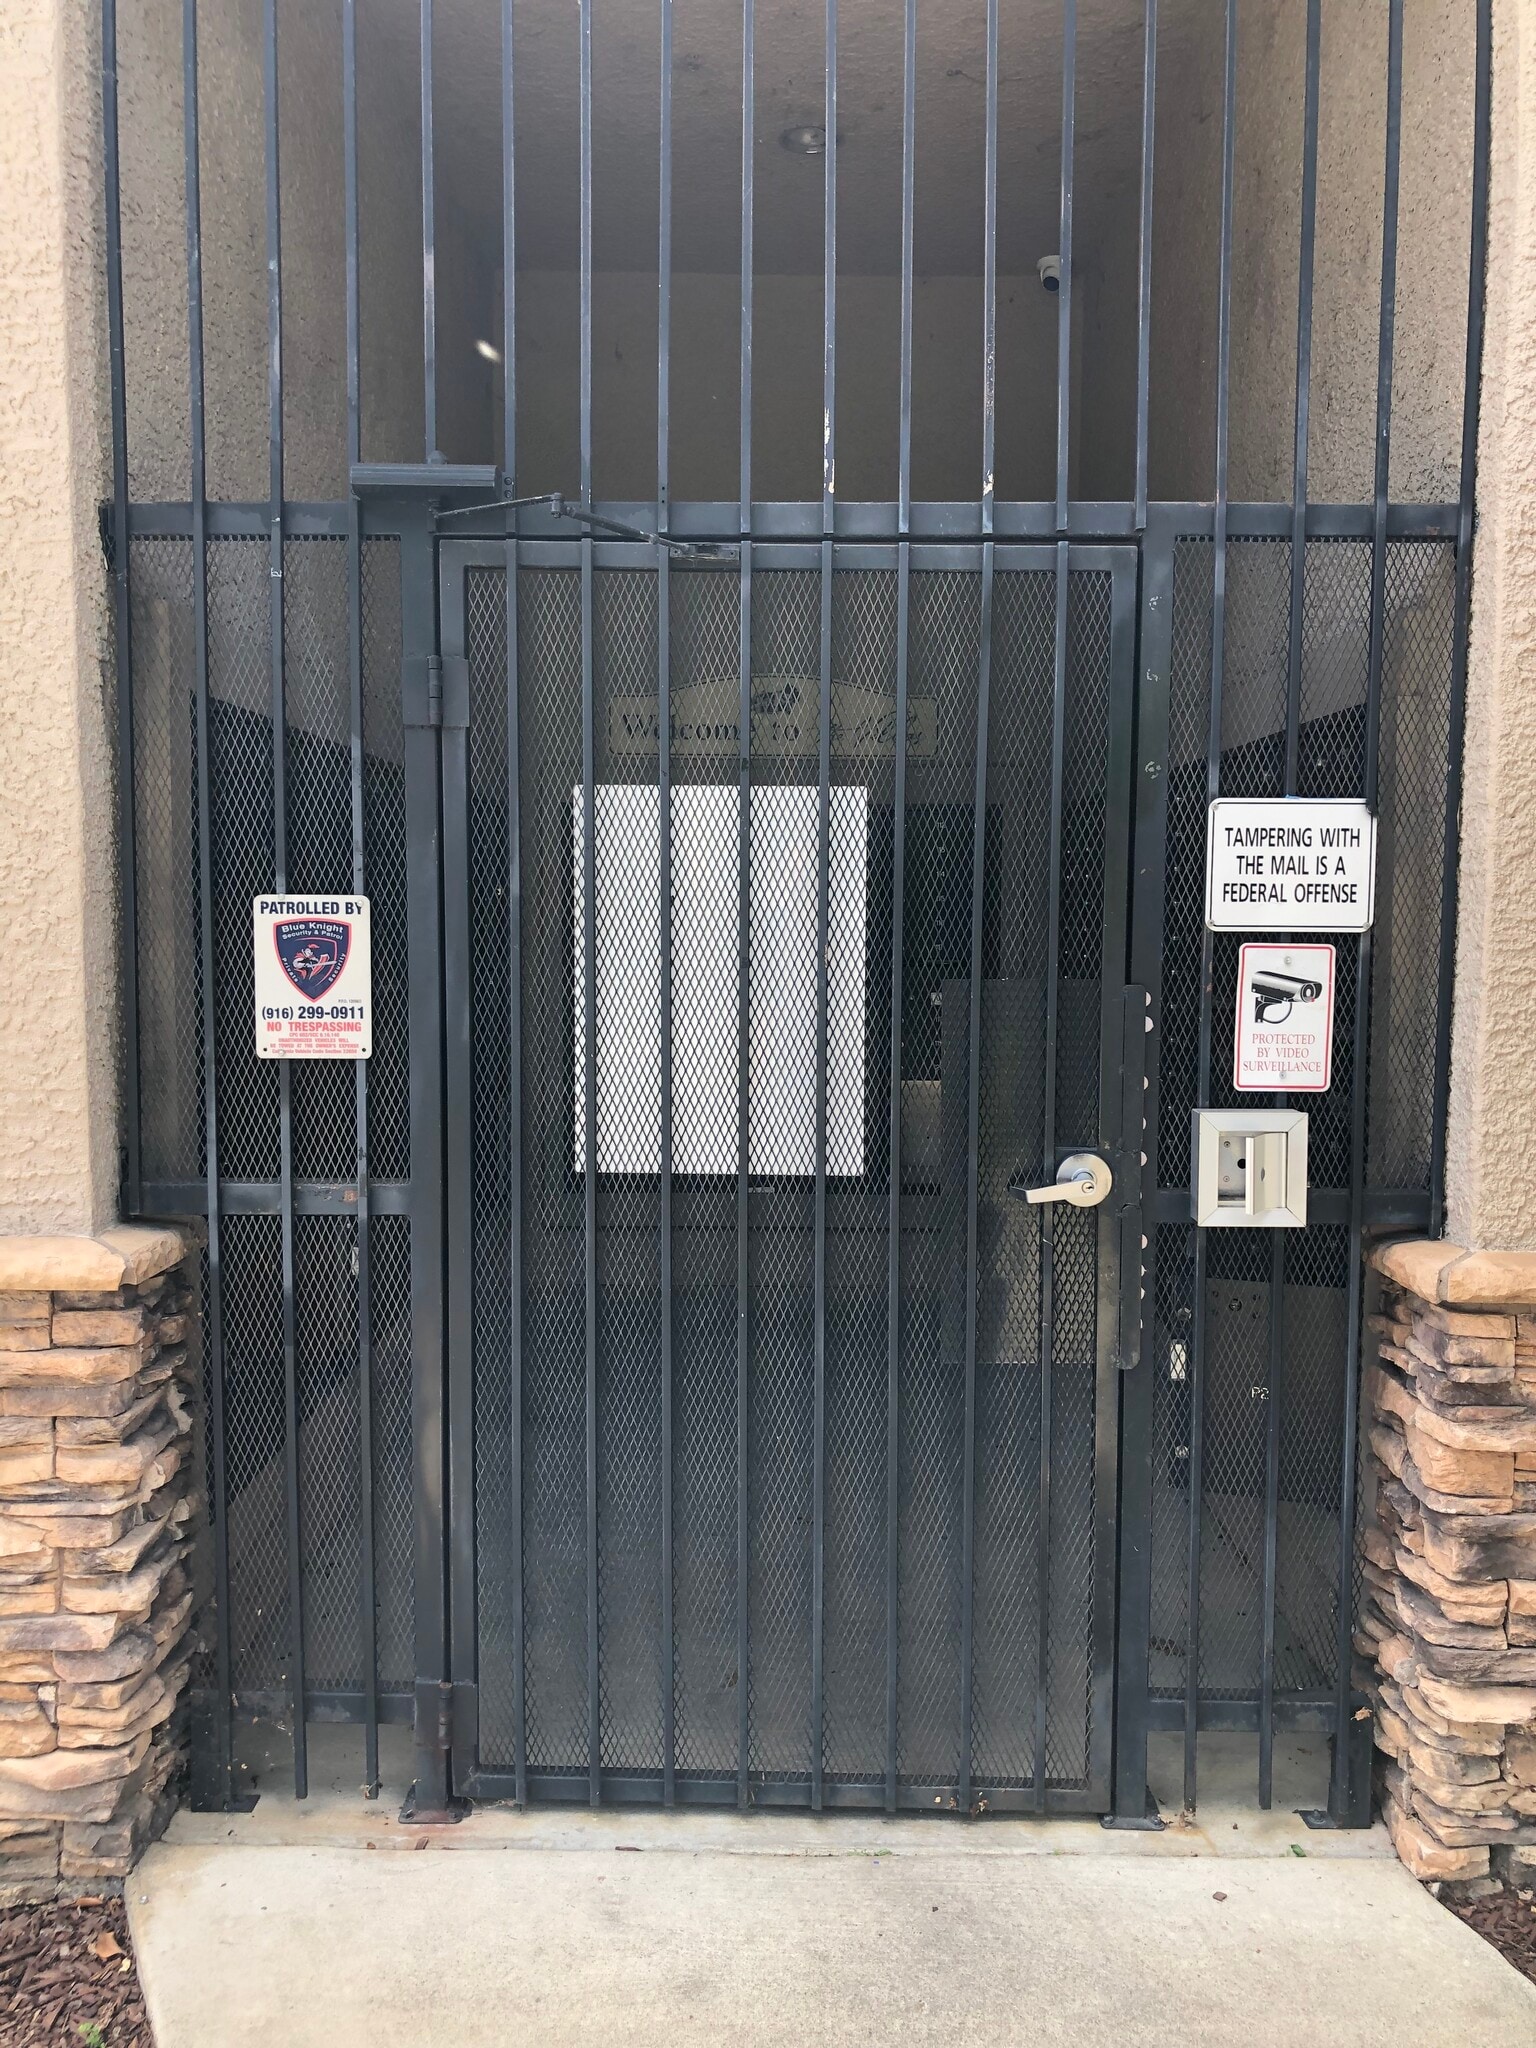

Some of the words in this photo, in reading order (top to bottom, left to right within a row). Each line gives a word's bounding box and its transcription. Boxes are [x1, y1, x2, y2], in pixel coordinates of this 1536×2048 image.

[622, 714, 756, 741] Welcom
[1225, 827, 1313, 848] TAMPERING
[1320, 828, 1361, 848] WITH
[1237, 855, 1264, 876] THE
[1271, 855, 1309, 876] MAIL
[1316, 856, 1328, 876] IS
[1334, 856, 1346, 876] A
[1223, 883, 1288, 903] FEDERAL
[1294, 883, 1358, 904] OFFENSE
[260, 901, 340, 915] PATROLLED
[345, 901, 362, 915] BY
[281, 922, 306, 933] Blue
[309, 921, 344, 934] Knight
[282, 929, 312, 941] Security
[321, 930, 343, 941] Patrol
[281, 957, 299, 983] Private
[328, 952, 346, 983] Security
[262, 1006, 294, 1020] (916)
[298, 1006, 364, 1020] 299-0911
[266, 1021, 282, 1032] NO
[288, 1021, 362, 1032] TRESPASSING
[1252, 1033, 1316, 1045] PROTECTED
[1257, 1047, 1271, 1058] BY
[1276, 1047, 1310, 1058] VIDEO
[1243, 1061, 1322, 1073] SURVEILLANCE
[1251, 1386, 1269, 1400] P2
